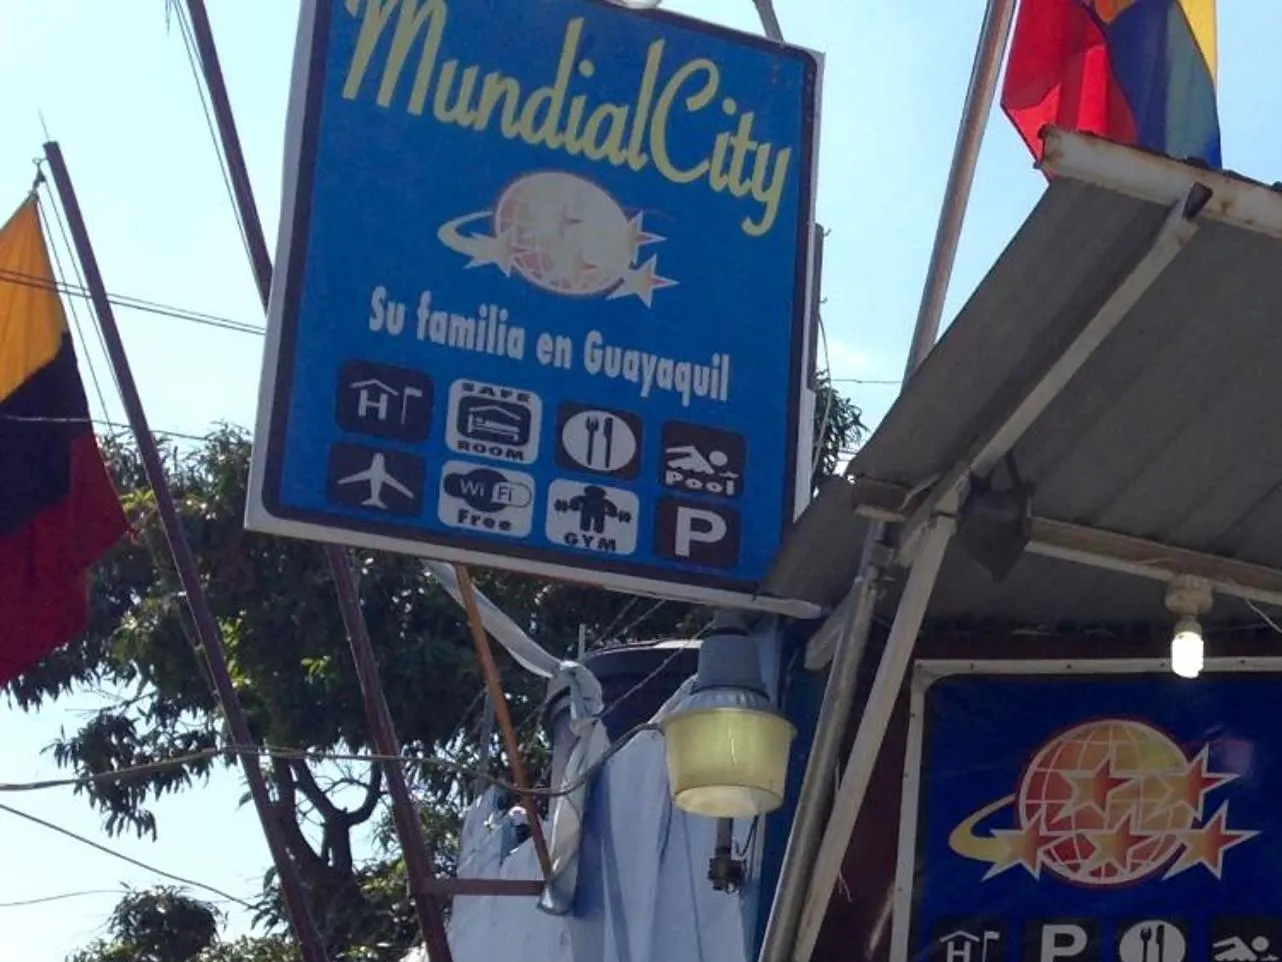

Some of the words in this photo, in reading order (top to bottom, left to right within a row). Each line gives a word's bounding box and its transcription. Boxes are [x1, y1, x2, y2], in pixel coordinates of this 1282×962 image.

[369, 286, 403, 336] Su
[416, 291, 526, 360] familia
[536, 332, 573, 369] en
[583, 330, 730, 407] Guayaquil
[461, 382, 532, 402] SAFE
[456, 441, 525, 461] ROOM
[665, 470, 735, 496] Pool
[457, 508, 512, 531] Free
[563, 532, 617, 552] GYM
[674, 506, 727, 557] P
